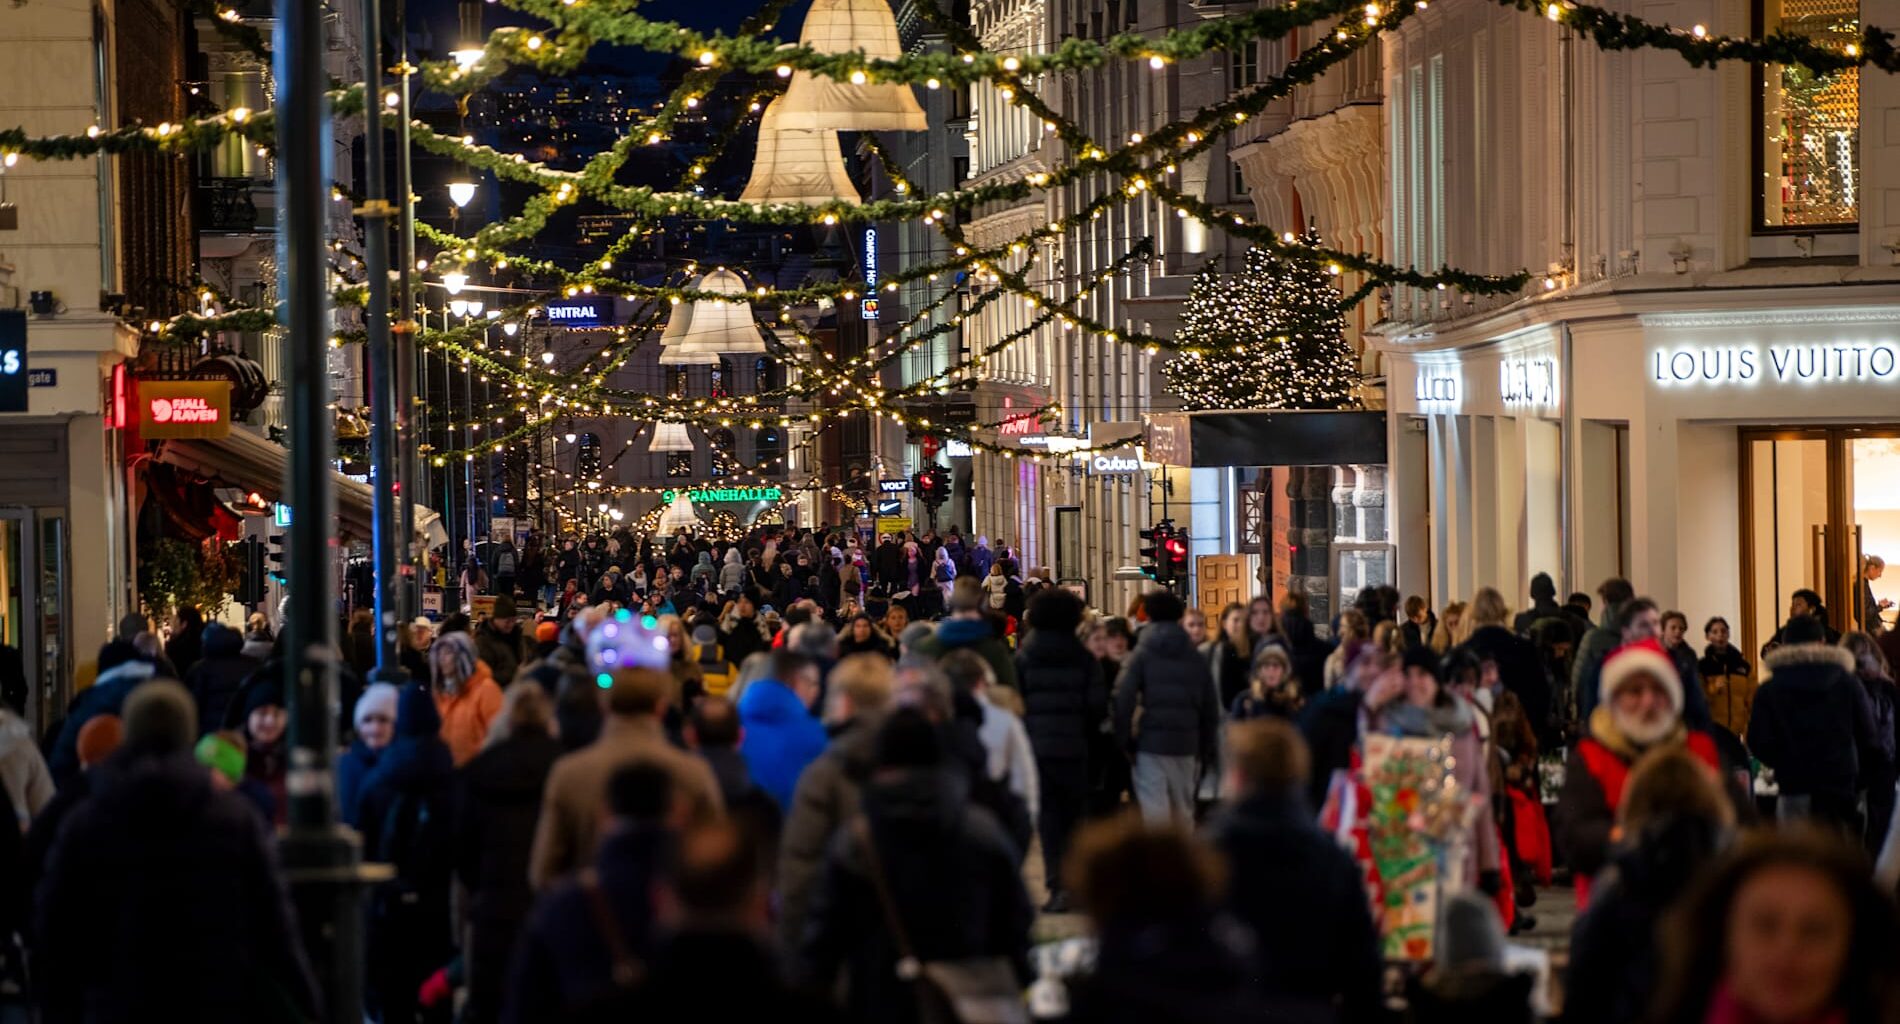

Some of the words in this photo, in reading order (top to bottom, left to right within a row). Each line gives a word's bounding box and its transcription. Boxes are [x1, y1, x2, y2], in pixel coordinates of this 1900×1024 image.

[865, 228, 877, 269] COMFORT
[547, 306, 597, 319] ENTRAL
[0, 349, 20, 375] S
[1656, 350, 1755, 380] LOUIS
[1769, 346, 1895, 380] VUITTO
[1094, 456, 1138, 471] Cubus
[881, 481, 908, 491] VOLT
